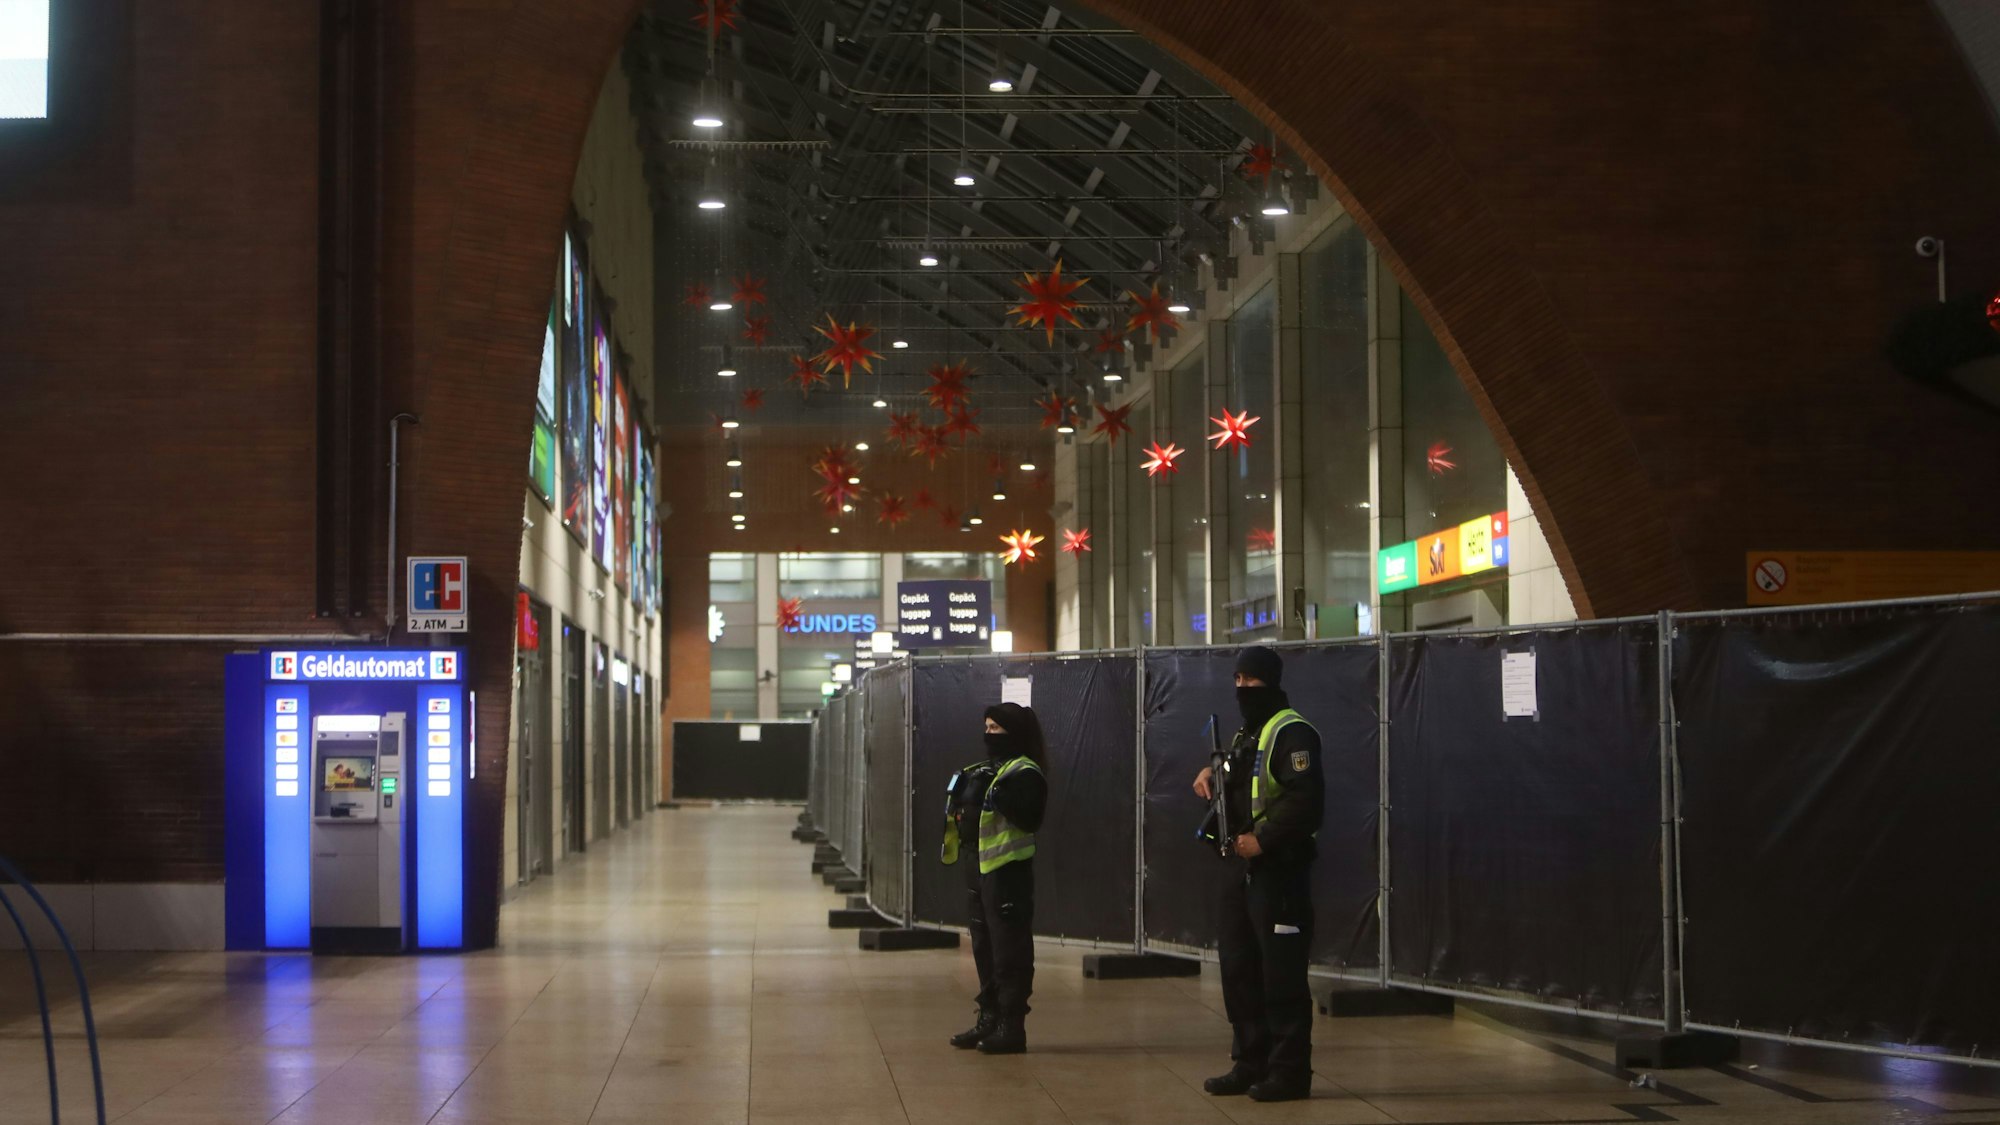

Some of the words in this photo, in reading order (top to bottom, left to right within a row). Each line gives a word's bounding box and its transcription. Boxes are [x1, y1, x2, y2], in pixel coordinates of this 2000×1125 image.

[901, 593, 930, 605] Gepäck
[949, 592, 977, 604] Gepäck
[901, 609, 931, 620] luggage
[949, 607, 978, 619] luggage
[411, 619, 421, 630] 2.
[424, 619, 447, 630] ATM
[901, 624, 930, 635] bagage
[949, 622, 977, 634] bagage
[301, 654, 426, 678] Geldautomat
